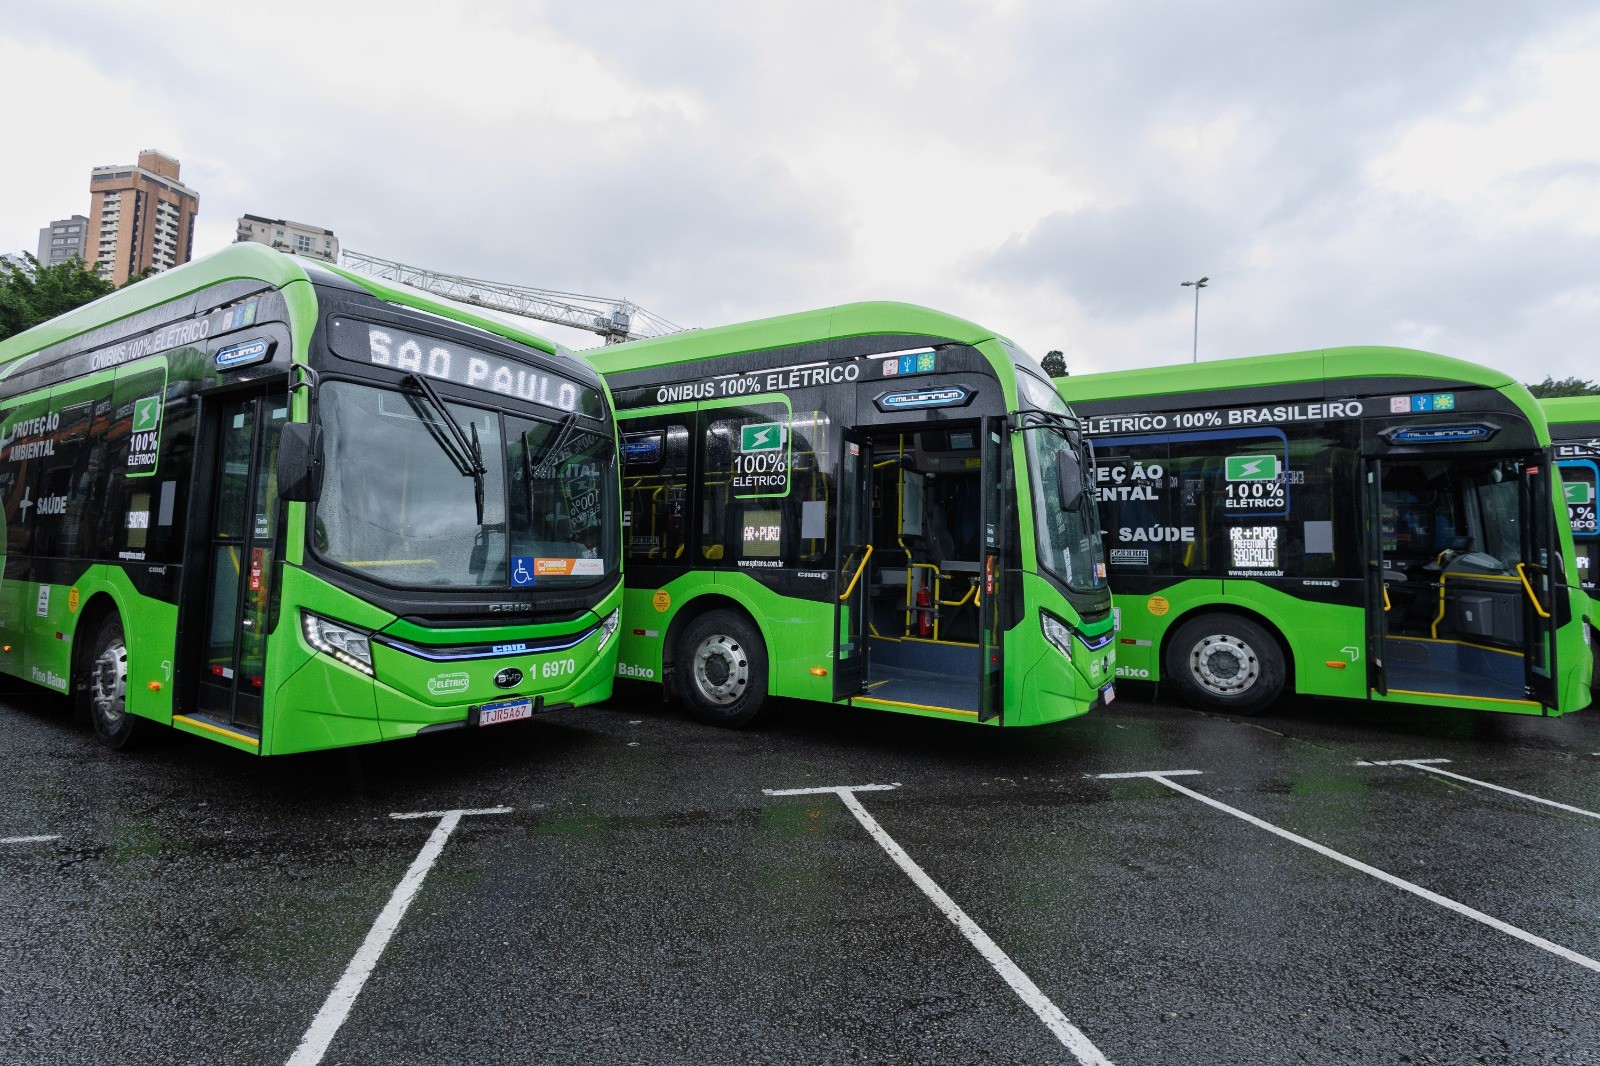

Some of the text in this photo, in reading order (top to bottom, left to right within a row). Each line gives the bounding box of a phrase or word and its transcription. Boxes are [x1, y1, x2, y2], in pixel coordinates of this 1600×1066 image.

[467, 357, 575, 411] PAULO
[656, 364, 860, 403] ÔNIBUS 100% ELÉTRICO
[12, 411, 60, 437] PROTEÇÃO
[1080, 401, 1363, 435] ELÉTRICO 100% BRASILEIRO
[9, 439, 55, 462] AMBIENTAL
[130, 431, 157, 452] 100%
[127, 452, 156, 466] ELÉTRICO
[734, 453, 785, 474] 100%
[733, 474, 786, 487] ELÉTRICO
[1095, 486, 1159, 501] ENTAL
[1225, 482, 1284, 498] 100%
[36, 492, 68, 515] SAÚDE
[1225, 497, 1285, 508] ELÉTRICO
[1118, 523, 1195, 542] SAÚDE
[1228, 569, 1284, 577] www.sptrans.com.br
[492, 643, 526, 652] CAIO
[32, 666, 67, 690] Piso Baixo
[529, 659, 575, 679] 1 6970
[618, 662, 654, 678] Baixo
[1115, 665, 1149, 678] aixo
[436, 677, 469, 689] ELÉTRICO
[485, 705, 527, 722] TJR5A67
